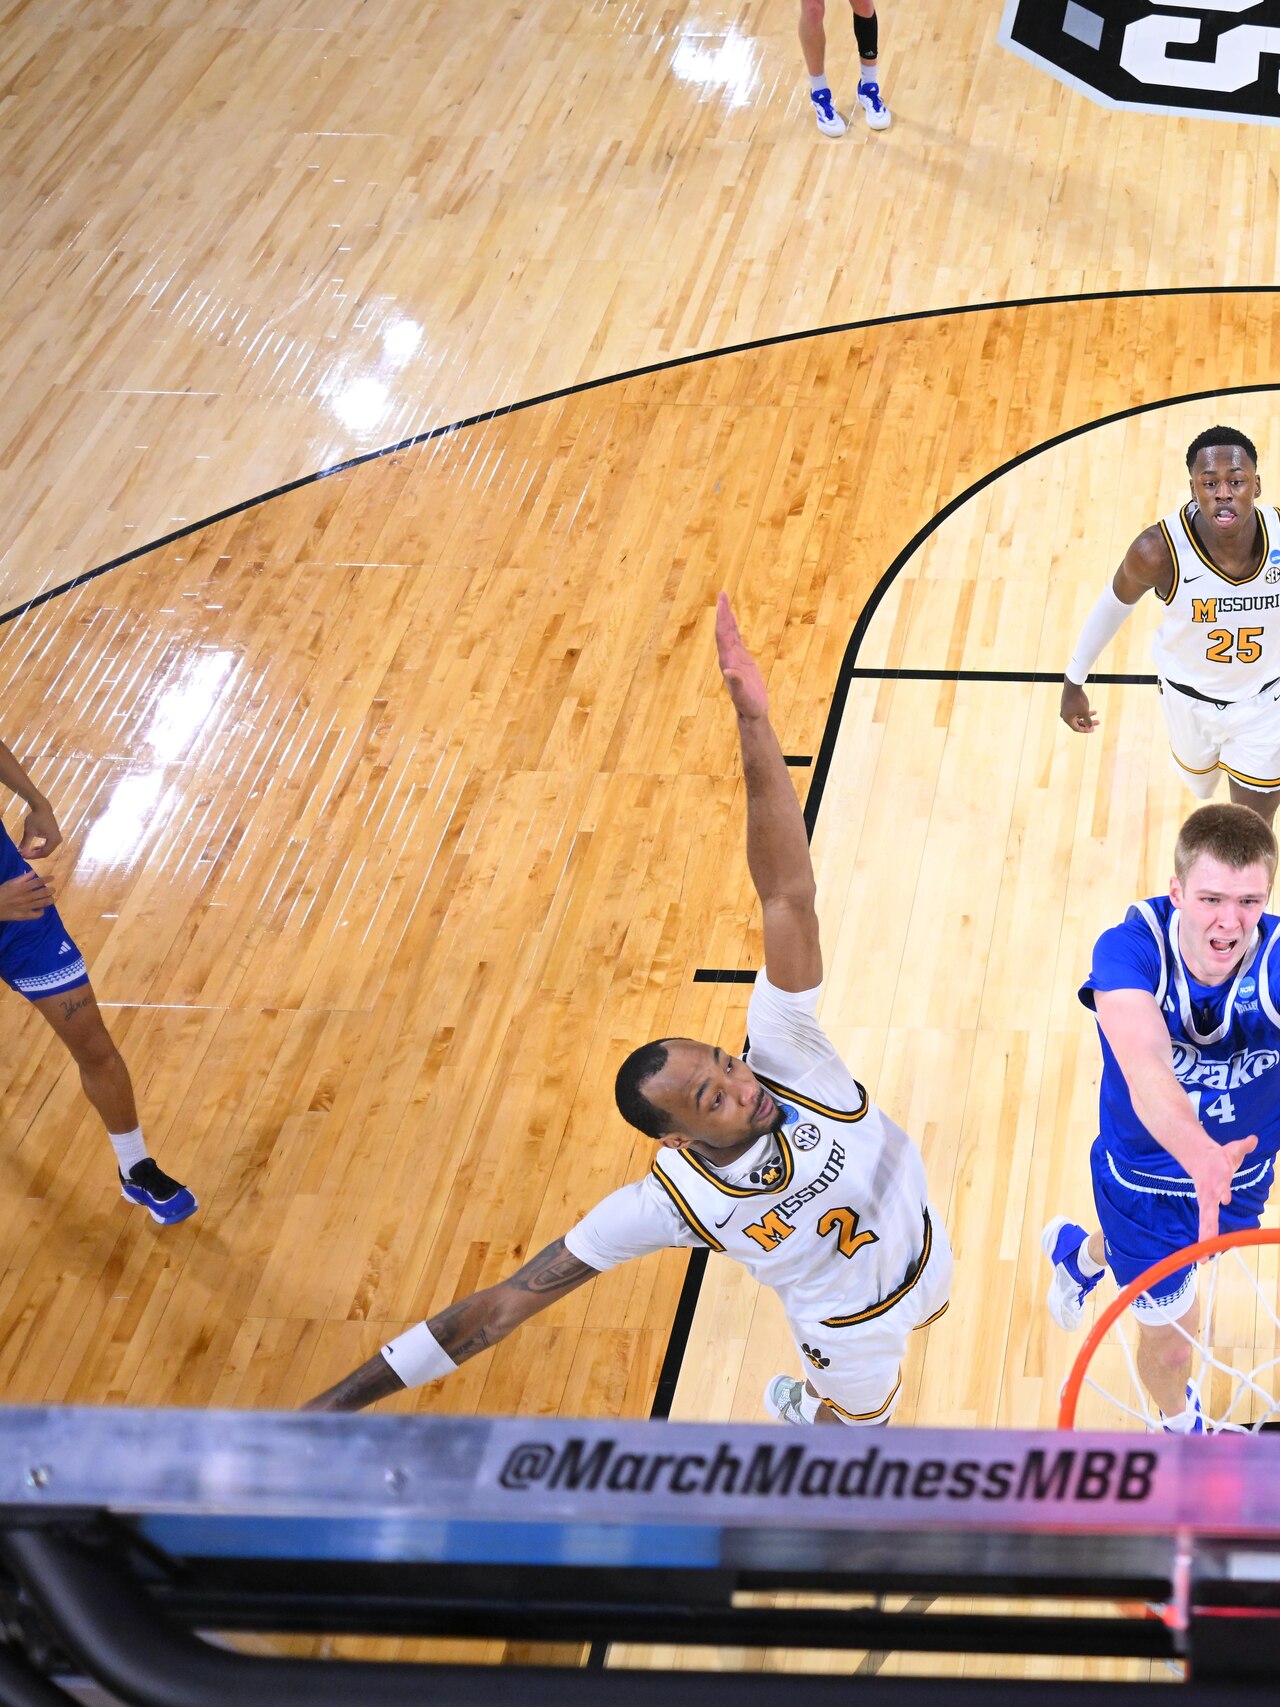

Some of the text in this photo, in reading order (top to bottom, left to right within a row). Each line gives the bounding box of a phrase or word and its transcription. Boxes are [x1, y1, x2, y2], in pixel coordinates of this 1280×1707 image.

[1265, 567, 1280, 584] SEC
[1192, 594, 1280, 623] MISSOURI
[1206, 626, 1264, 663] 25
[1172, 1041, 1280, 1090] Drake
[794, 1124, 820, 1150] SEC
[742, 1138, 846, 1252] MISSOURI
[816, 1206, 880, 1260] 2
[498, 1439, 1158, 1503] @MarchMadnessMBB
